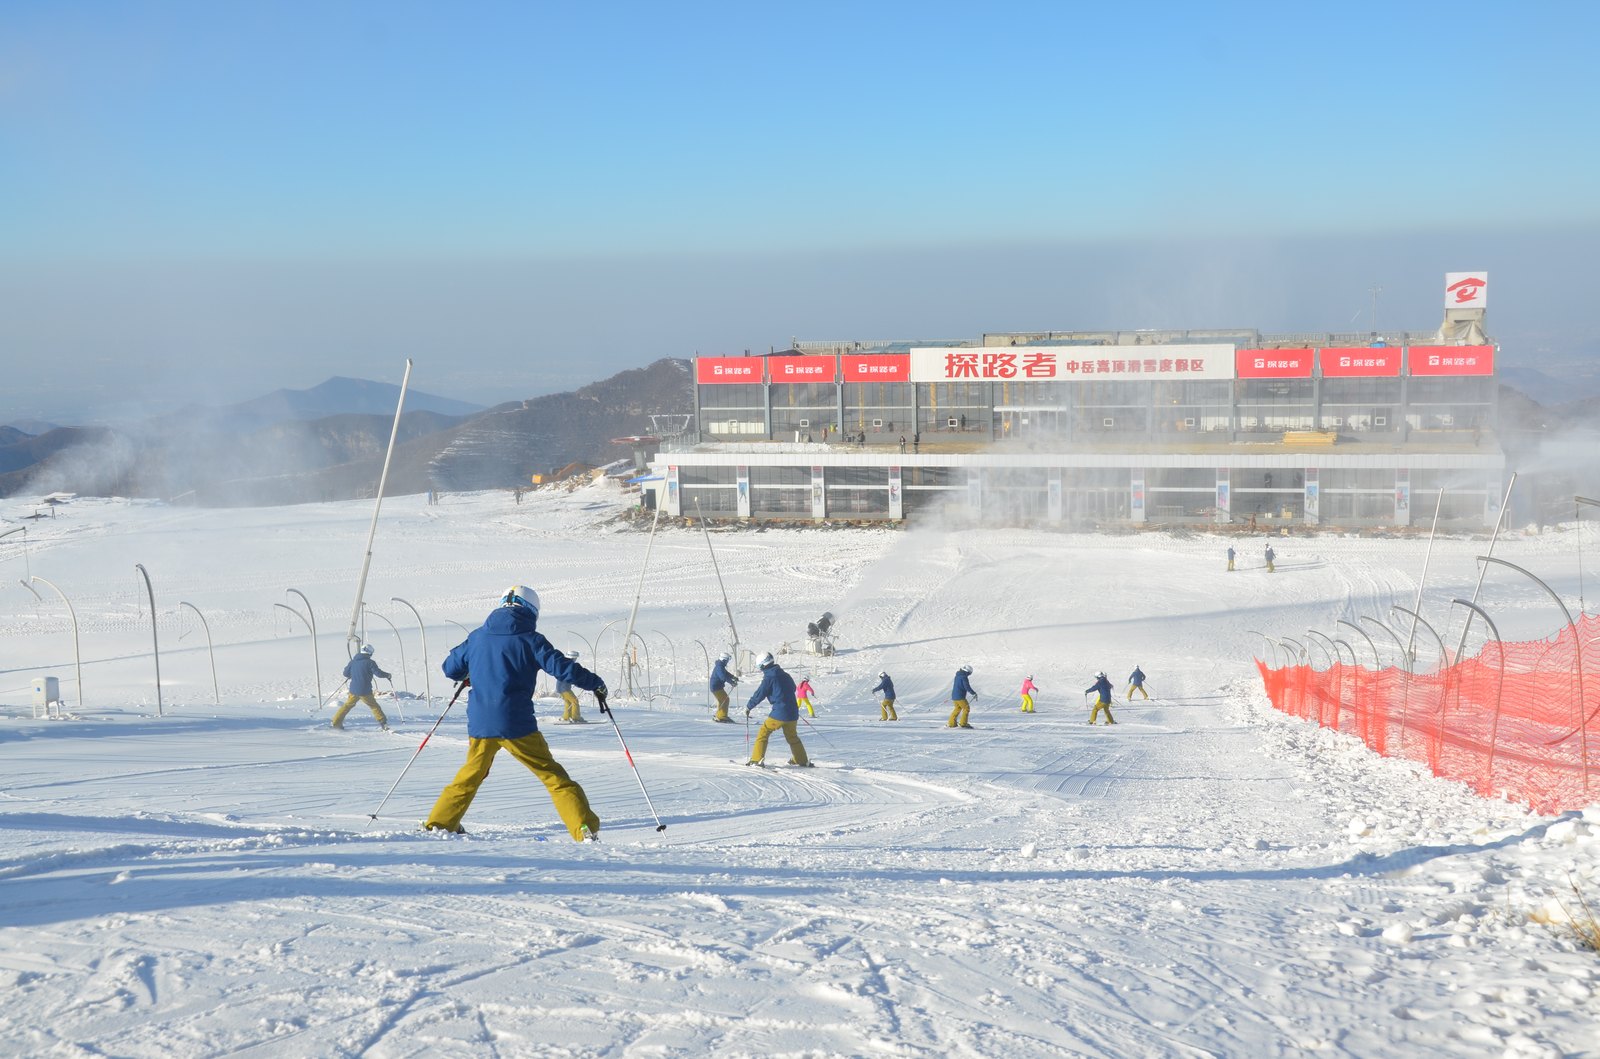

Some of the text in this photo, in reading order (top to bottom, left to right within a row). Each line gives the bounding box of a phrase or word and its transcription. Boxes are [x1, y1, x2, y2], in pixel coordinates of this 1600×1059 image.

[944, 352, 1204, 379] 探路者 中岳嵩顶滑雪度假区
